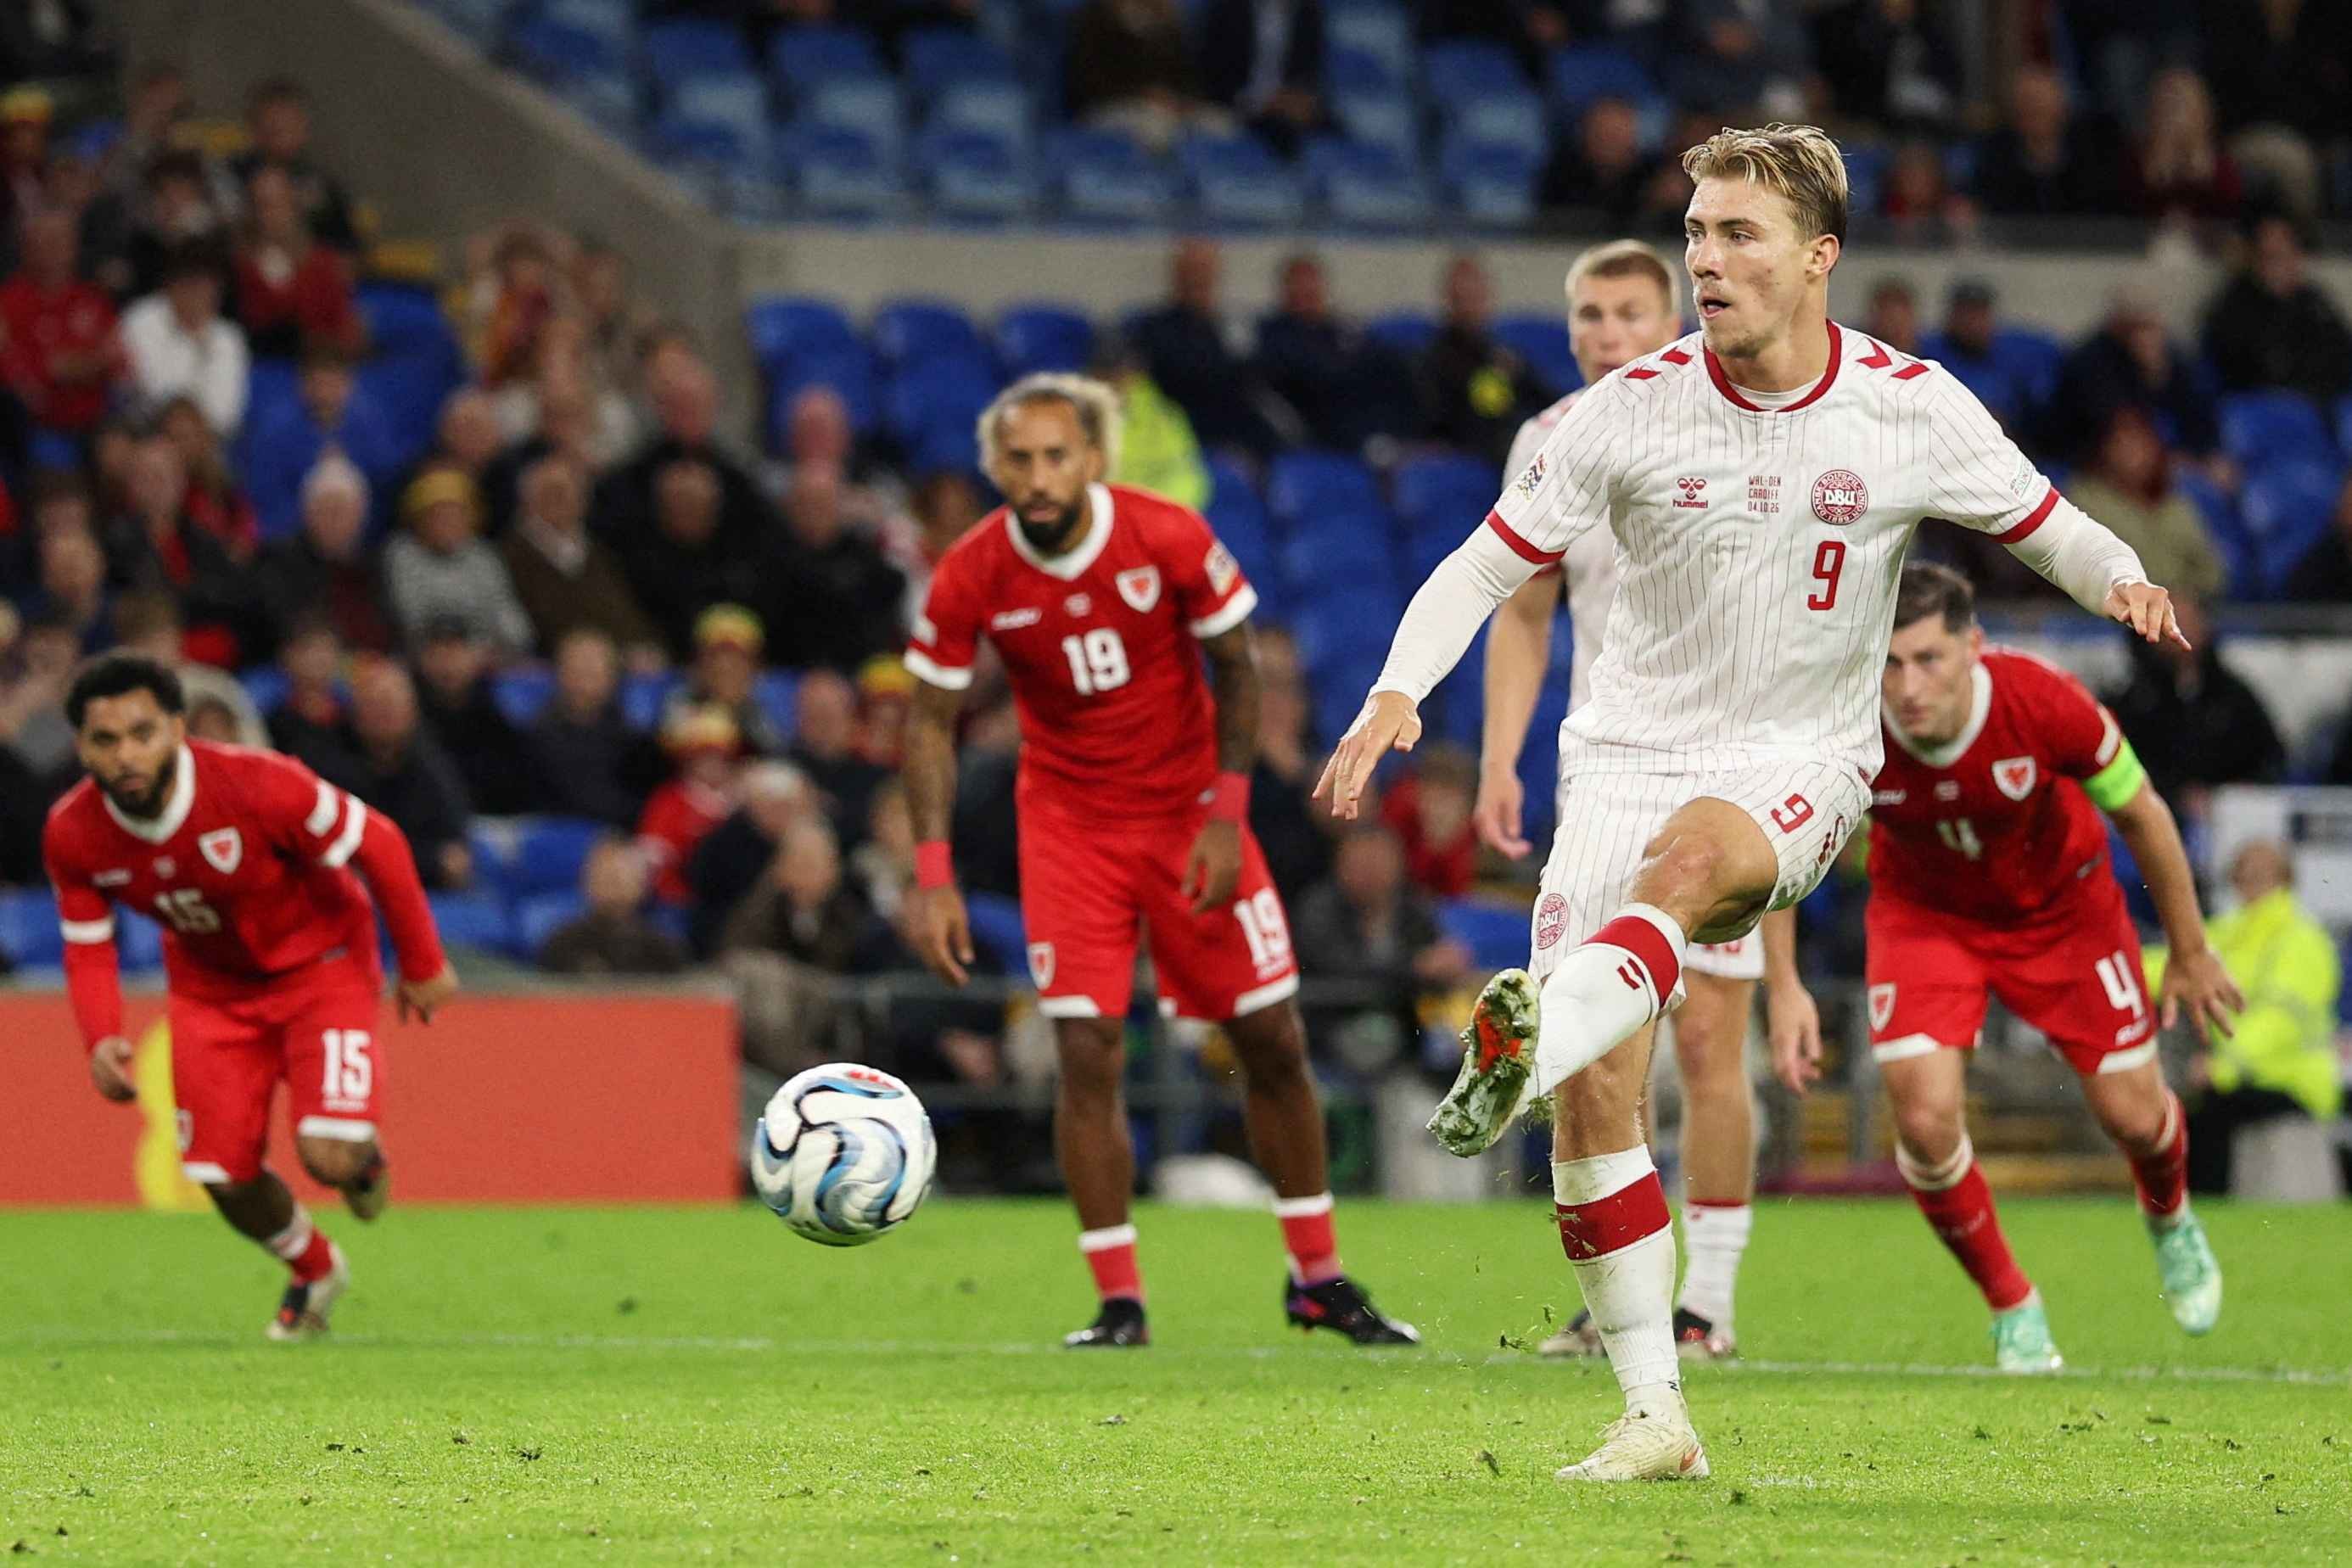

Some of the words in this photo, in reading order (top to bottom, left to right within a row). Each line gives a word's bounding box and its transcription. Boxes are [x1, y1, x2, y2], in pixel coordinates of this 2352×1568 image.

[1672, 499, 1709, 509] hummel
[1748, 488, 1779, 500] CARDIFF
[1824, 489, 1856, 507] DBU
[1807, 540, 1846, 611] 9
[1061, 628, 1131, 696] 19
[1770, 792, 1814, 834] 9
[1937, 817, 1981, 860] 4
[154, 888, 219, 933] 15
[1234, 888, 1291, 966] 19
[2094, 950, 2145, 1019] 4
[322, 1028, 372, 1100] 15
